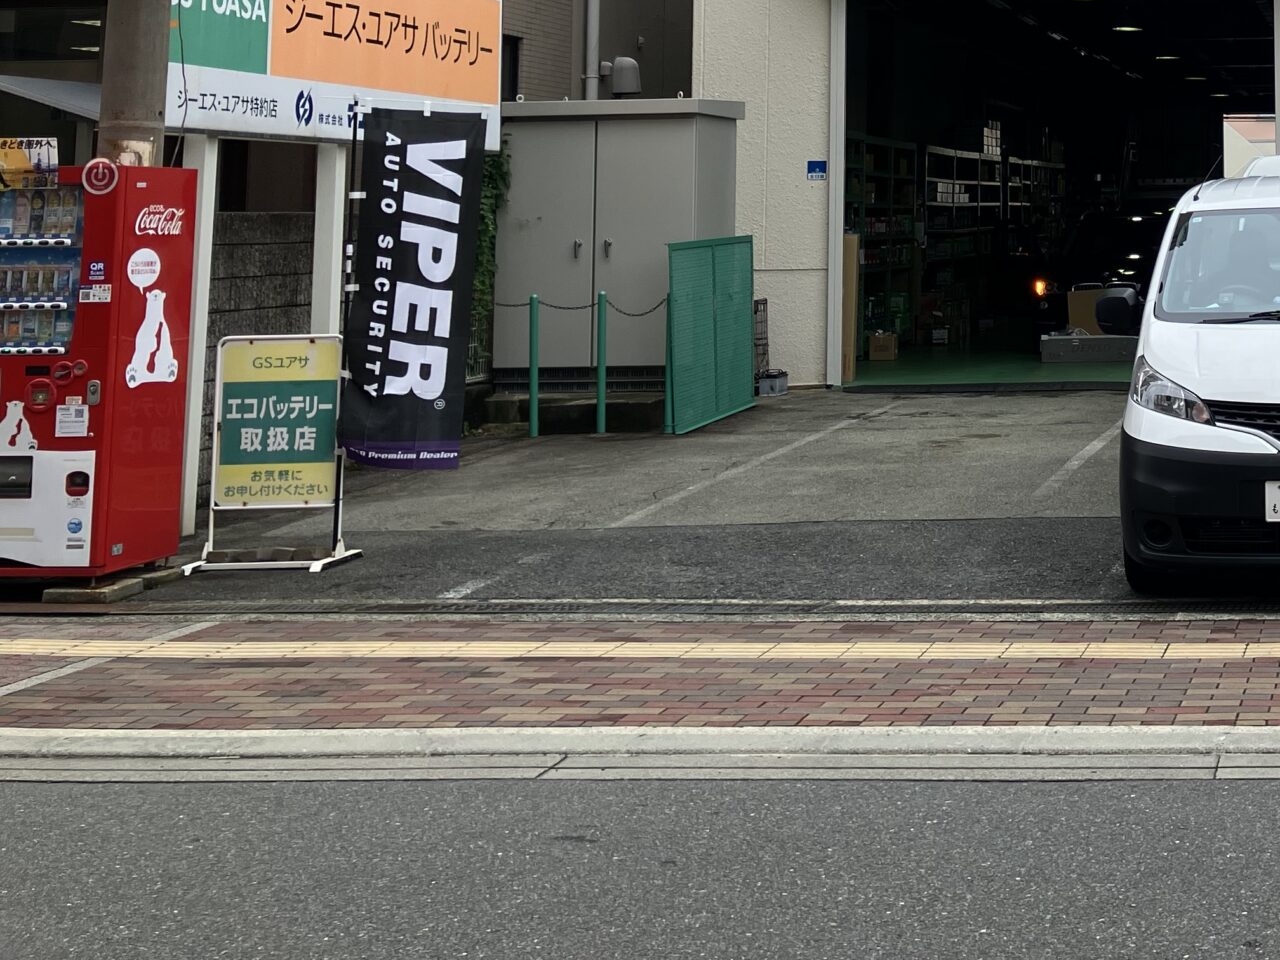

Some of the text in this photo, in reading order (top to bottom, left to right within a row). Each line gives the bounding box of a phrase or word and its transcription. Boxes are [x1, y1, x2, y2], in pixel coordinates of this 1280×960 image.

[177, 89, 278, 118] ジーエス・ユアサ特約店
[318, 113, 343, 127] 株式会社
[90, 262, 104, 271] QR
[363, 131, 402, 398] AUTO SECURITY
[383, 139, 467, 401] VIPER
[252, 356, 310, 369] GSユアサ
[226, 395, 333, 420] エコバッテリー
[240, 426, 317, 452] 取扱店
[368, 451, 458, 459] Premium Dealer
[251, 469, 303, 483] お気軽に
[223, 484, 329, 498] お申し付けください
